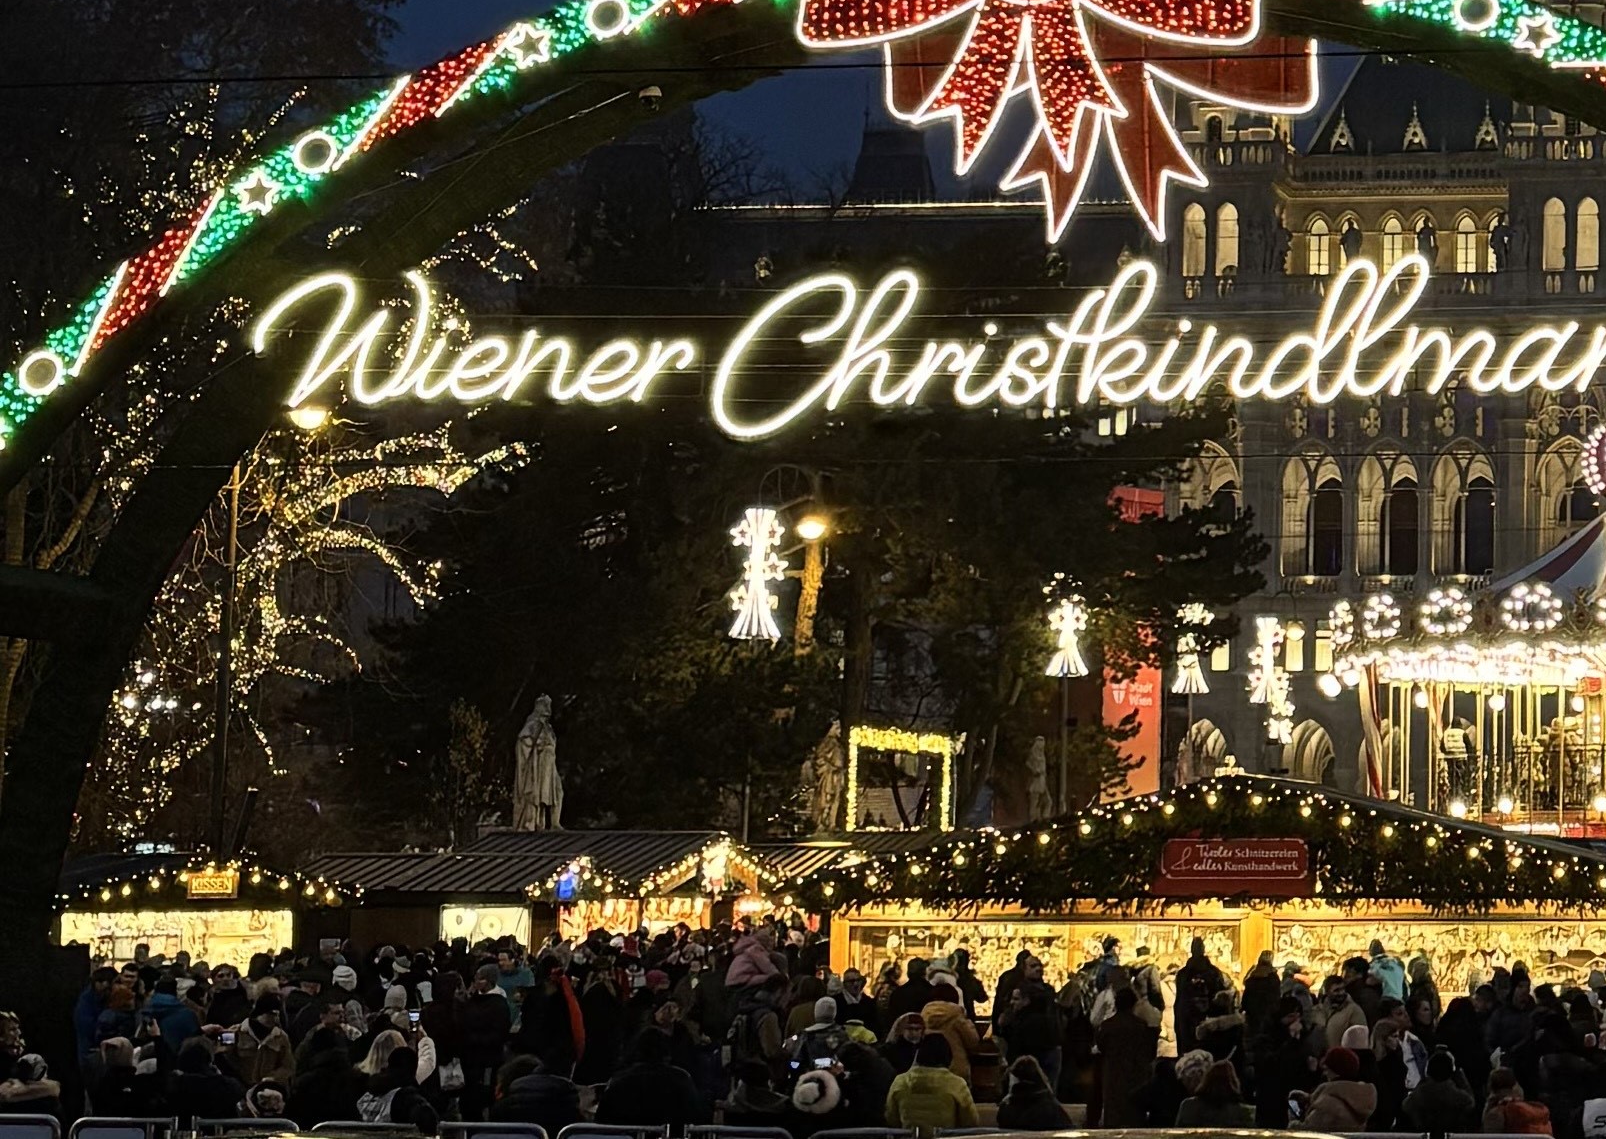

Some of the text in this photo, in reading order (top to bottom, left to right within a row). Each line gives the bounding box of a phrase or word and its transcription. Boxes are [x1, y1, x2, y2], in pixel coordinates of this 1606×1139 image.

[252, 268, 697, 409] Wiener
[1129, 682, 1153, 694] Stadt
[1129, 694, 1153, 707] Wien
[1234, 848, 1299, 858] Schnitzereien
[1193, 859, 1222, 871] edler
[1223, 861, 1299, 871] Kunsthandwerk
[191, 877, 233, 891] KISSEN
